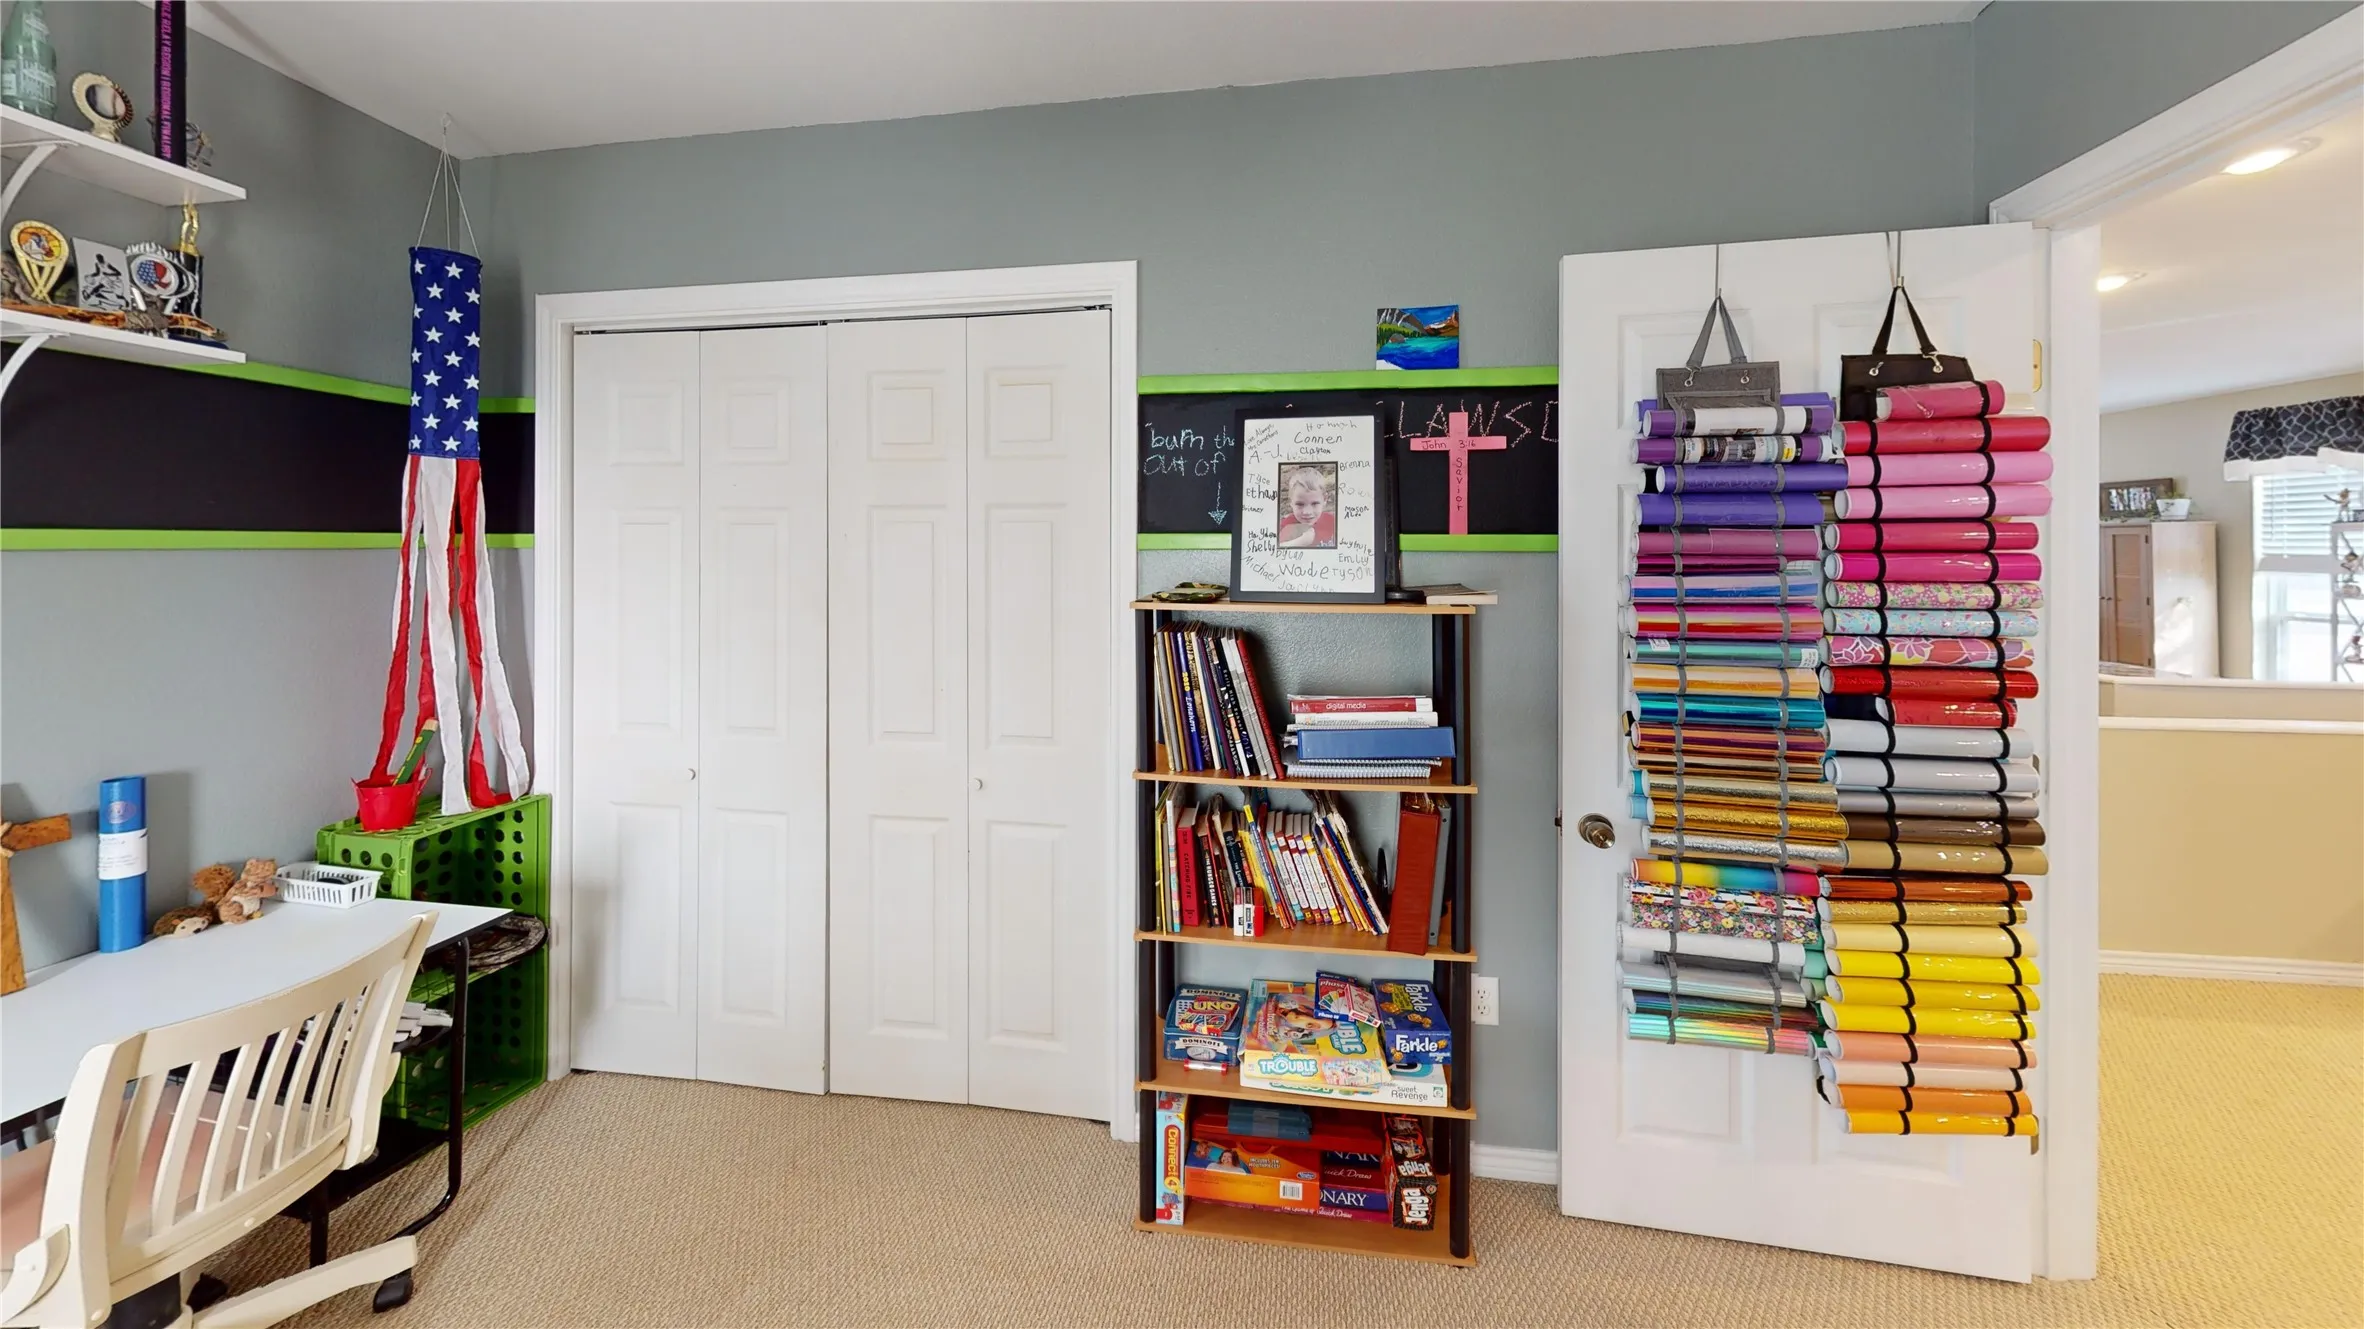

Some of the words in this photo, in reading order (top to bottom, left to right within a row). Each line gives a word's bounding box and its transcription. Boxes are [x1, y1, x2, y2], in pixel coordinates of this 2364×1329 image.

[1422, 441, 1447, 450] John
[1459, 440, 1476, 448] 3:16
[1279, 561, 1330, 580] Wade
[1182, 671, 1190, 692] 2010
[1326, 702, 1346, 711] digital
[1346, 702, 1367, 710] media
[1405, 983, 1433, 1012] Farkle
[1193, 1001, 1235, 1011] UNO
[1395, 1034, 1438, 1053] Farkle
[1260, 1060, 1317, 1075] TROUBLE
[1391, 1090, 1428, 1102] Revenge
[1168, 1128, 1179, 1178] Connect
[1346, 1169, 1372, 1180] Draw
[1398, 1161, 1433, 1177] Jenga
[1168, 1179, 1177, 1187] 4
[1402, 1188, 1430, 1225] Jenga
[1336, 1210, 1352, 1219] Draw
